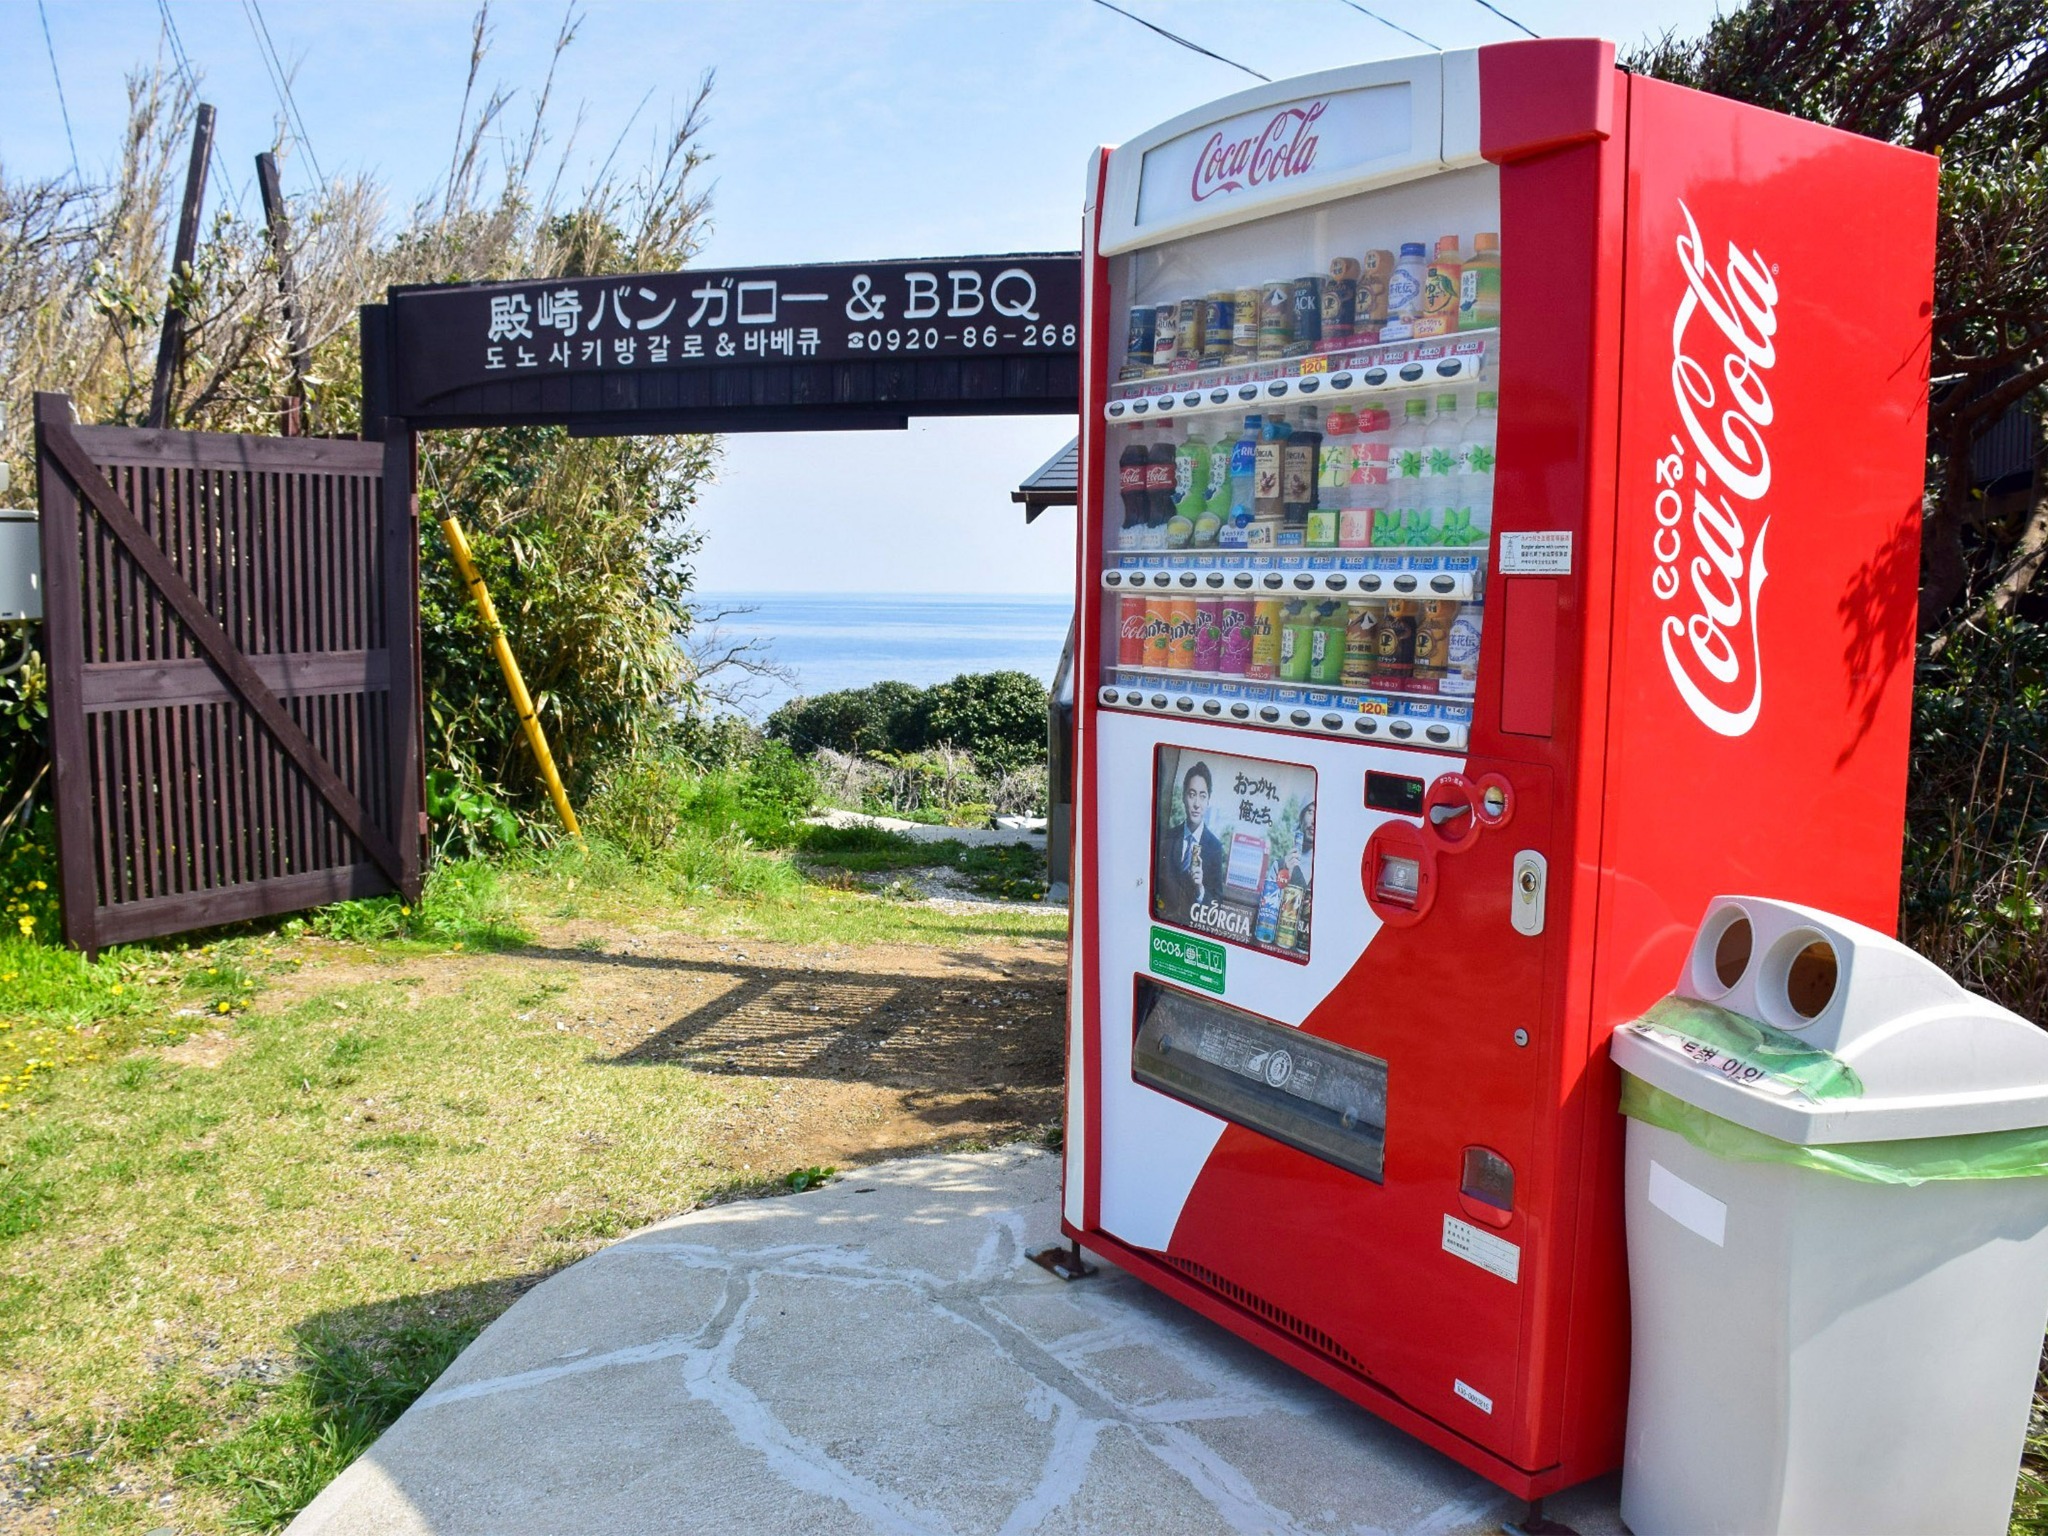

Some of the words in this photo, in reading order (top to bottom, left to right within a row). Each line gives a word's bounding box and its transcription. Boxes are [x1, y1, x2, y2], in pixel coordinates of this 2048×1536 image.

[1191, 99, 1330, 202] Coca-Cola
[487, 278, 829, 343] 殿崎バンガロー
[846, 274, 887, 321] &
[903, 268, 1041, 320] BBQ
[1662, 197, 1779, 737] Coca-Cola
[1190, 900, 1250, 937] GEORGIA
